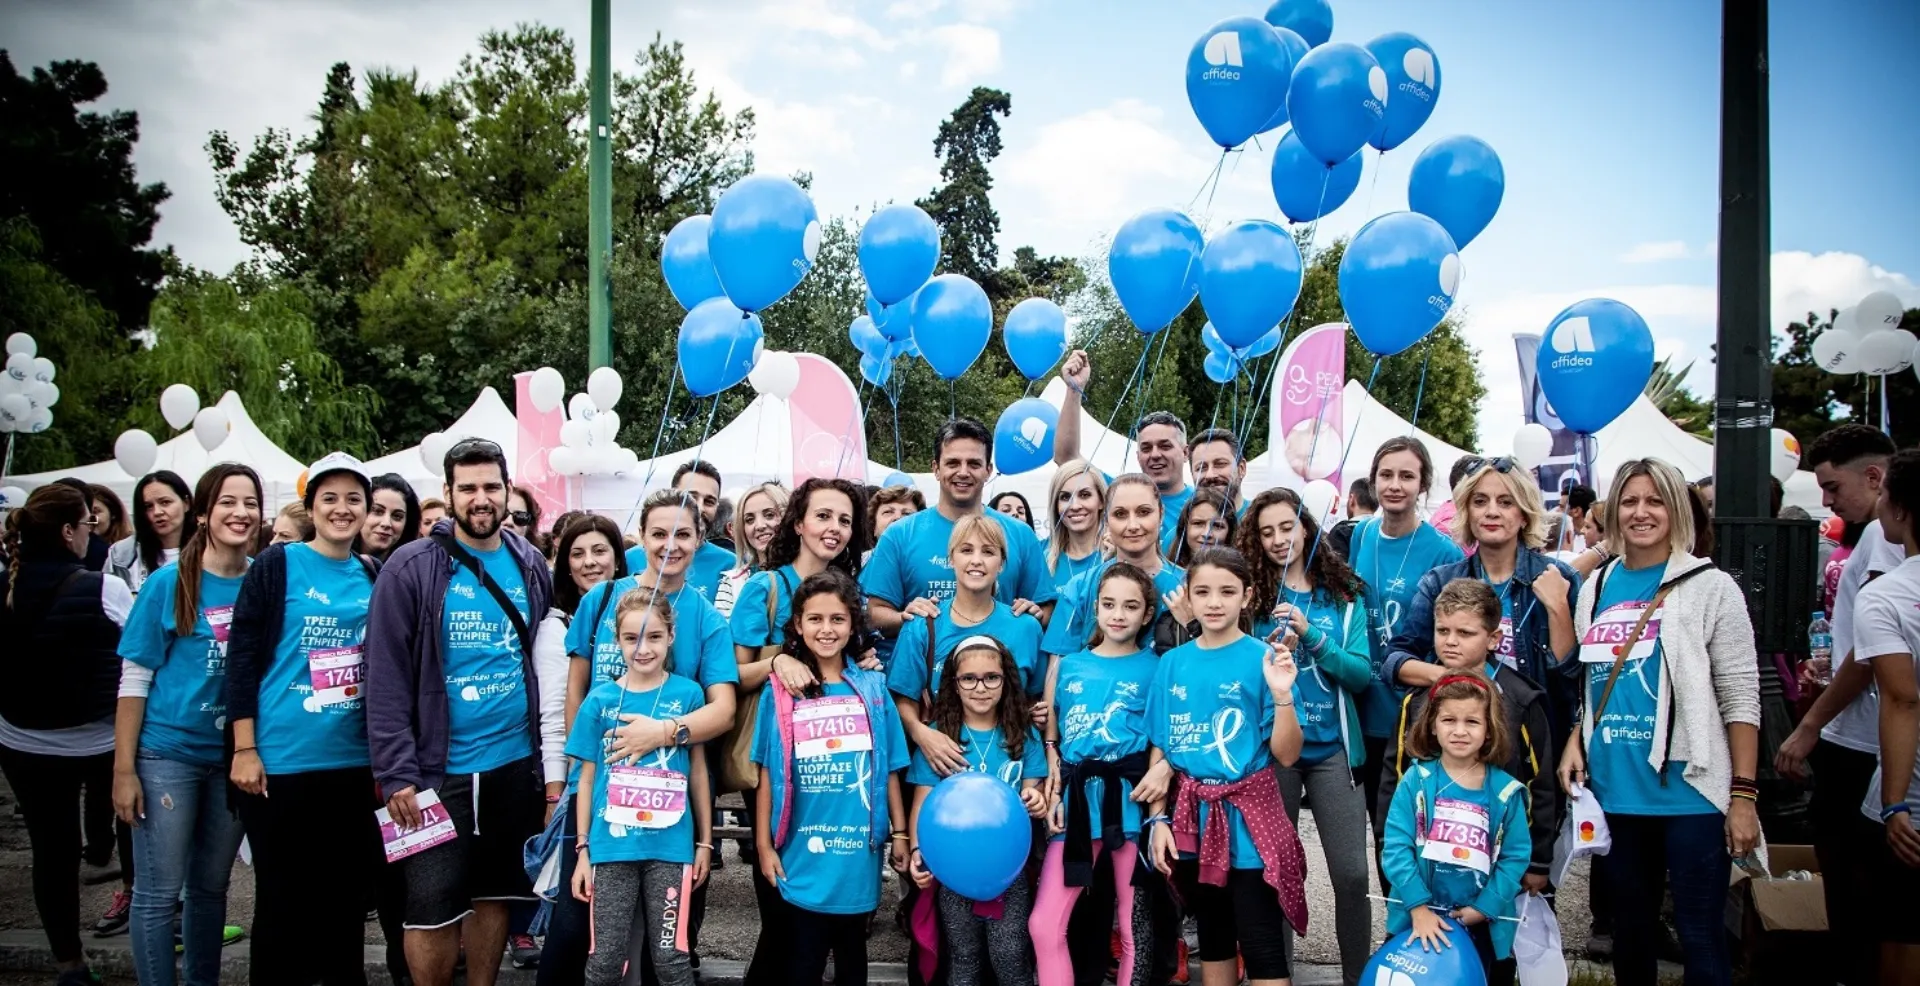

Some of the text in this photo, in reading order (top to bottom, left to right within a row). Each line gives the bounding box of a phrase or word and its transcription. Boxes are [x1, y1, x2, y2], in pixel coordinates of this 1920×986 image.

[1203, 67, 1241, 81] affidea
[1399, 81, 1431, 102] affidea
[1552, 355, 1593, 369] affidea
[304, 616, 338, 626] ΤΡΕΞΕ
[449, 611, 482, 621] ΤΡΕΞΕ
[449, 621, 498, 632] ΓΙΟΡΤΑΣΕ
[449, 631, 492, 641] ΣΤΗΡΙΞΕ
[479, 682, 516, 695] affidea
[806, 716, 856, 738] 17416
[798, 762, 852, 773] ΓΙΟΡΤΑΣΕ
[801, 774, 844, 784] ΣΤΗΡΙΞΕ
[619, 788, 675, 809] 17367
[1437, 822, 1487, 850] 17354
[825, 837, 863, 849] affidea
[660, 899, 678, 949] READY
[1385, 952, 1429, 975] affidea
